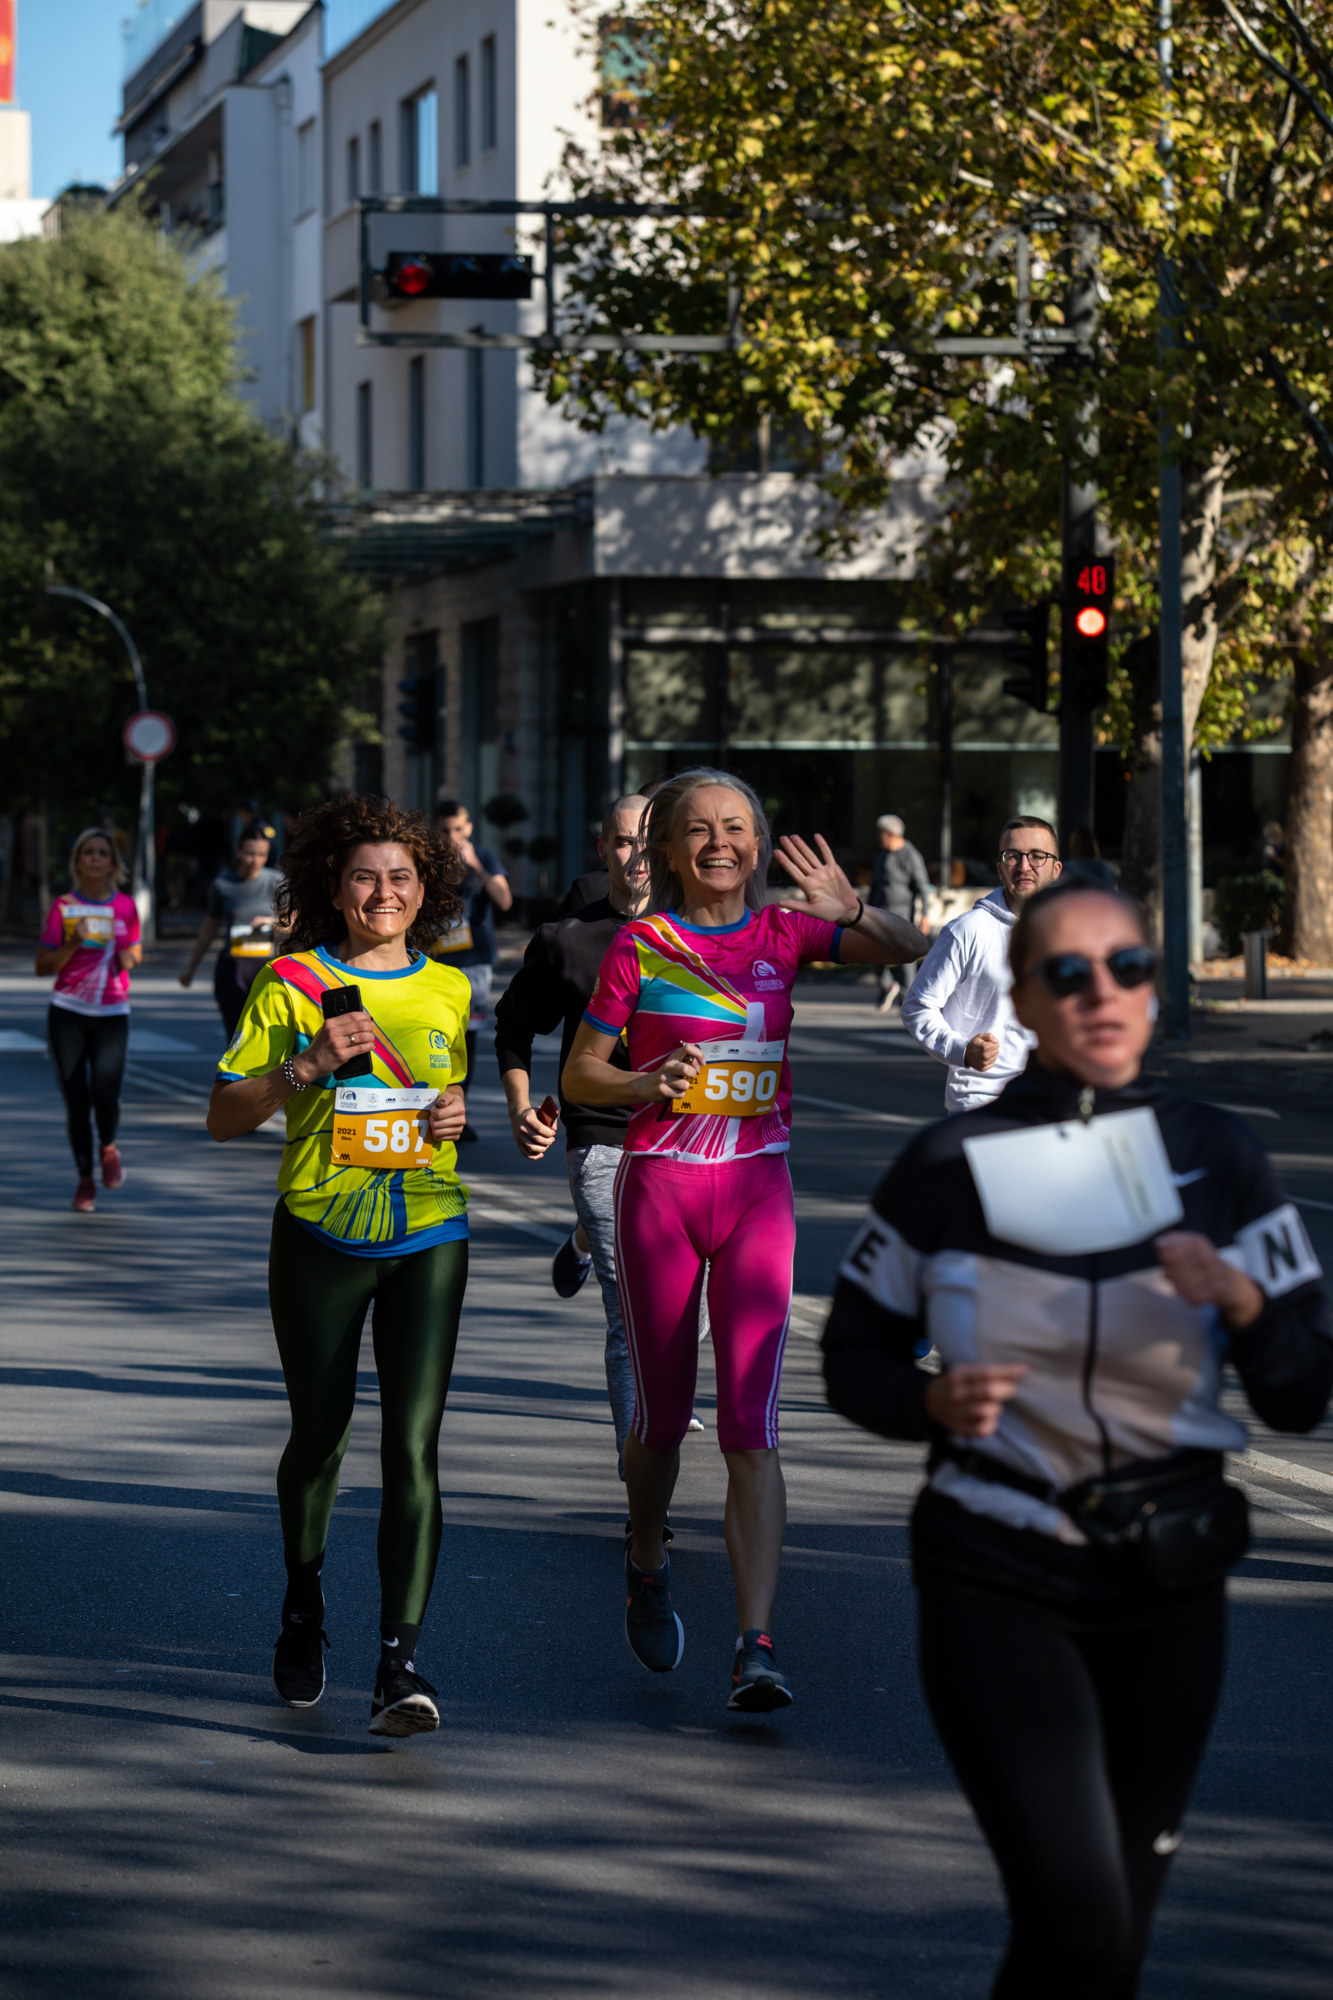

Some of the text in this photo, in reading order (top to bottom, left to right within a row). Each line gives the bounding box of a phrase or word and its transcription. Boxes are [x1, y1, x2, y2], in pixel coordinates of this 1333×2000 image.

[1077, 565, 1106, 595] 40
[704, 1068, 777, 1102] 590
[337, 1127, 356, 1135] 2021
[363, 1119, 429, 1153] 587
[850, 1229, 889, 1275] E
[1263, 1223, 1299, 1280] N
